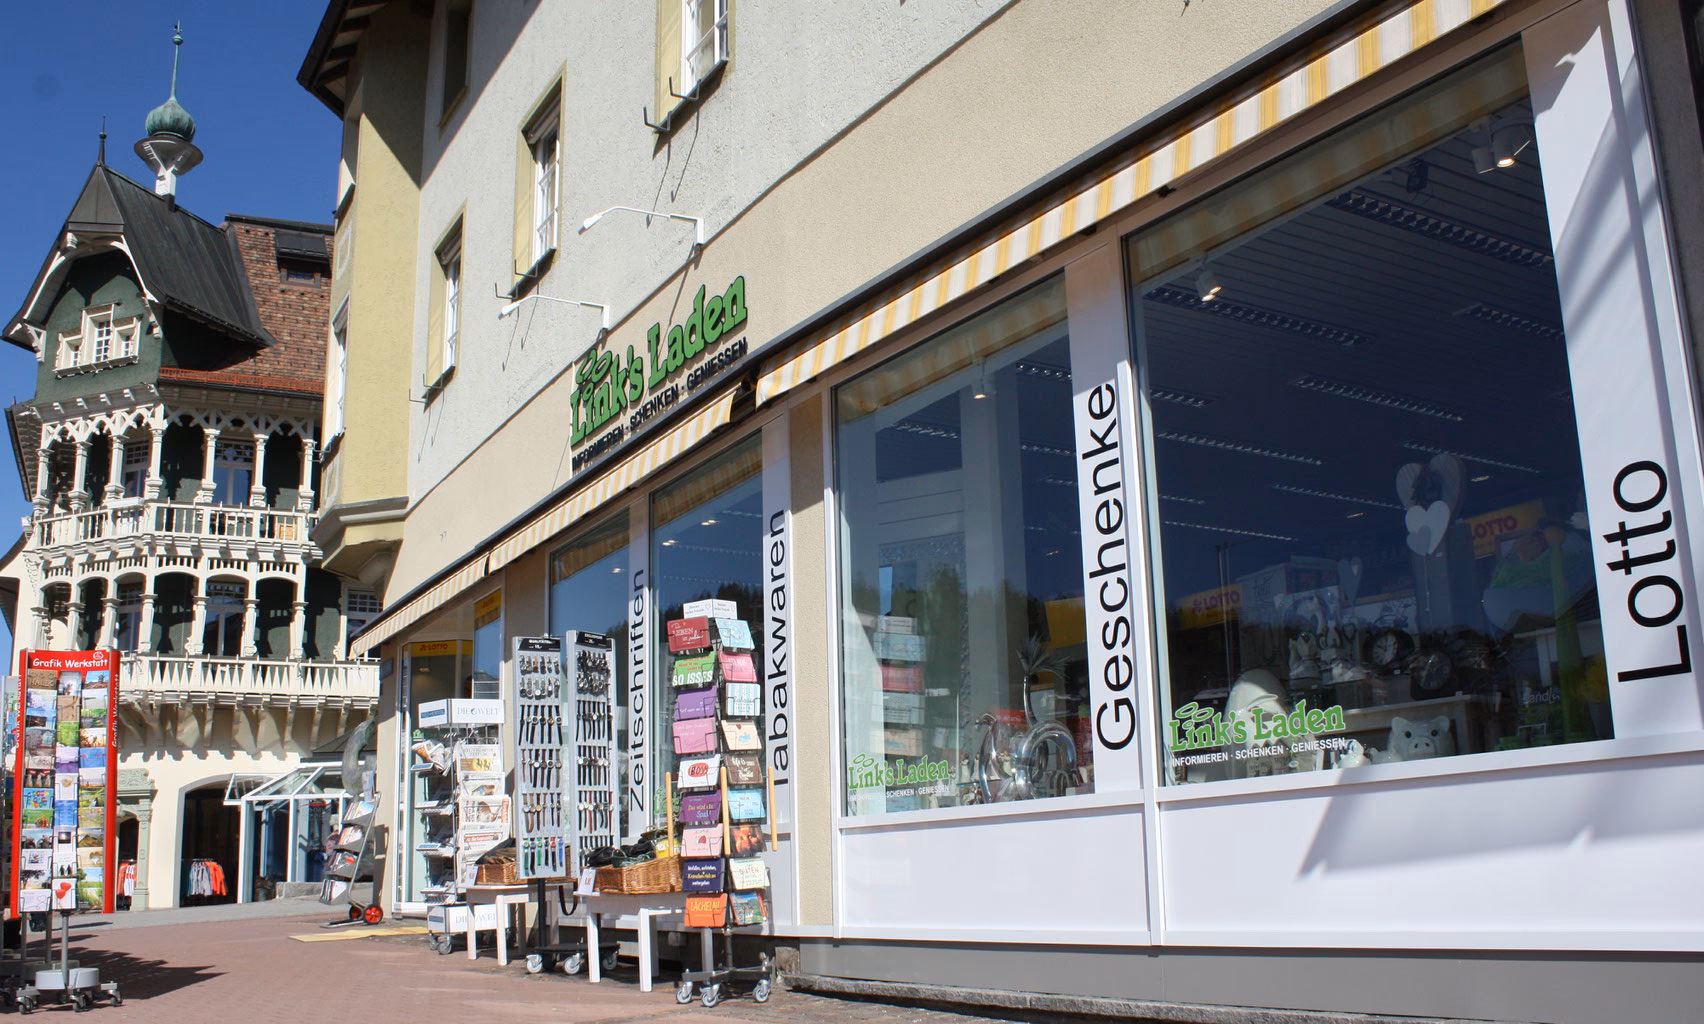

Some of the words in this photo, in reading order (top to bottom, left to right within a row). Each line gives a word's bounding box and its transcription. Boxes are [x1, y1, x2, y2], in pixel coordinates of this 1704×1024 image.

[570, 345, 643, 447] Link's
[647, 276, 747, 389] Laden
[572, 424, 624, 472] INFORMIEREN
[630, 383, 679, 431] SCHENKEN
[687, 337, 747, 391] GENIESSEN
[1472, 515, 1517, 539] OTTO
[1082, 383, 1136, 750] Geschenke
[1603, 460, 1692, 683] Lotto
[33, 658, 62, 667] Grafik
[64, 659, 108, 668] Werkstatt
[672, 673, 684, 687] SO
[629, 568, 645, 812] Zeitschriften
[457, 707, 470, 715] DIE
[476, 707, 499, 715] WELT
[1169, 710, 1247, 751] Link's
[1252, 699, 1346, 740] Laden
[1172, 752, 1228, 767] INFORMIEREN
[1235, 745, 1284, 759] SCHENKEN
[1291, 737, 1347, 753] GENIESSEN
[848, 760, 894, 789] Link's
[896, 754, 950, 784] Laden
[886, 788, 914, 798] SCHENKEN
